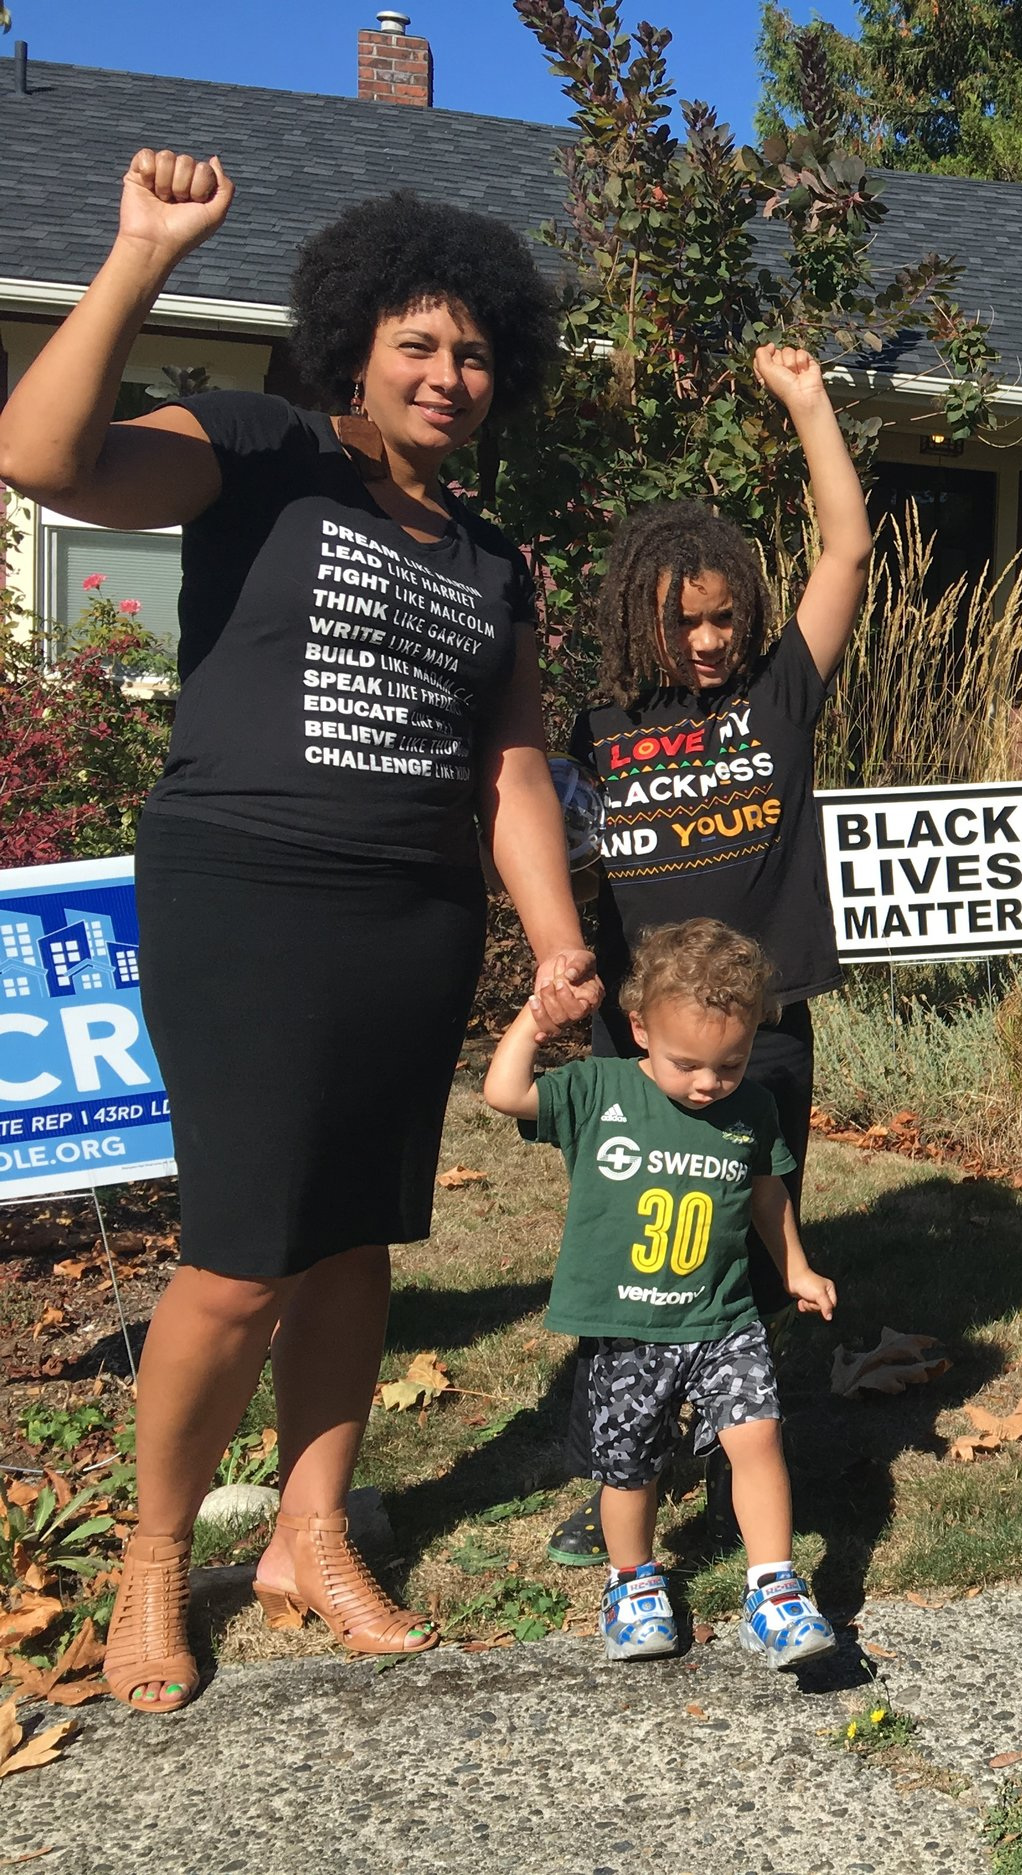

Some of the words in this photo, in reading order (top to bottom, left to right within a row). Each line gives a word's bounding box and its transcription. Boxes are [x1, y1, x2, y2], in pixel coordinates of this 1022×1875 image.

[322, 520, 400, 561] DREAM
[403, 556, 434, 577] LIKE
[321, 542, 382, 569] LEAD
[388, 562, 418, 585] LIKE
[421, 577, 475, 609] HARRIET
[312, 588, 389, 621] THINK
[393, 609, 423, 634] LIKE
[427, 624, 482, 655] GARVEY
[317, 564, 390, 595] FIGHT
[395, 585, 425, 610] LIKE
[430, 602, 495, 639] MALCOLM
[305, 642, 375, 668] BUILD
[380, 654, 409, 676] LIKE
[309, 616, 386, 646] WRITE
[388, 634, 420, 658] LIKE
[421, 647, 459, 673] MAYA
[303, 669, 382, 696] SPEAK
[388, 681, 418, 700] LIKE
[303, 694, 409, 724] EDUCATE
[304, 720, 397, 749] BELIEVE
[399, 736, 427, 753] LIKE
[610, 728, 705, 770] LOVE
[305, 746, 432, 777] CHALLENGE
[435, 763, 454, 779] LIKE
[671, 798, 781, 848] YOURS
[837, 805, 1020, 851] BLACK
[840, 852, 1022, 898] LIVES
[0, 1003, 151, 1101] CR
[0, 1118, 24, 1137] TE
[31, 1112, 73, 1132] REP
[93, 1105, 143, 1123] 43RD
[647, 1150, 748, 1182] SWEDISH
[631, 1187, 713, 1276] 30
[618, 1284, 694, 1306] verizon
